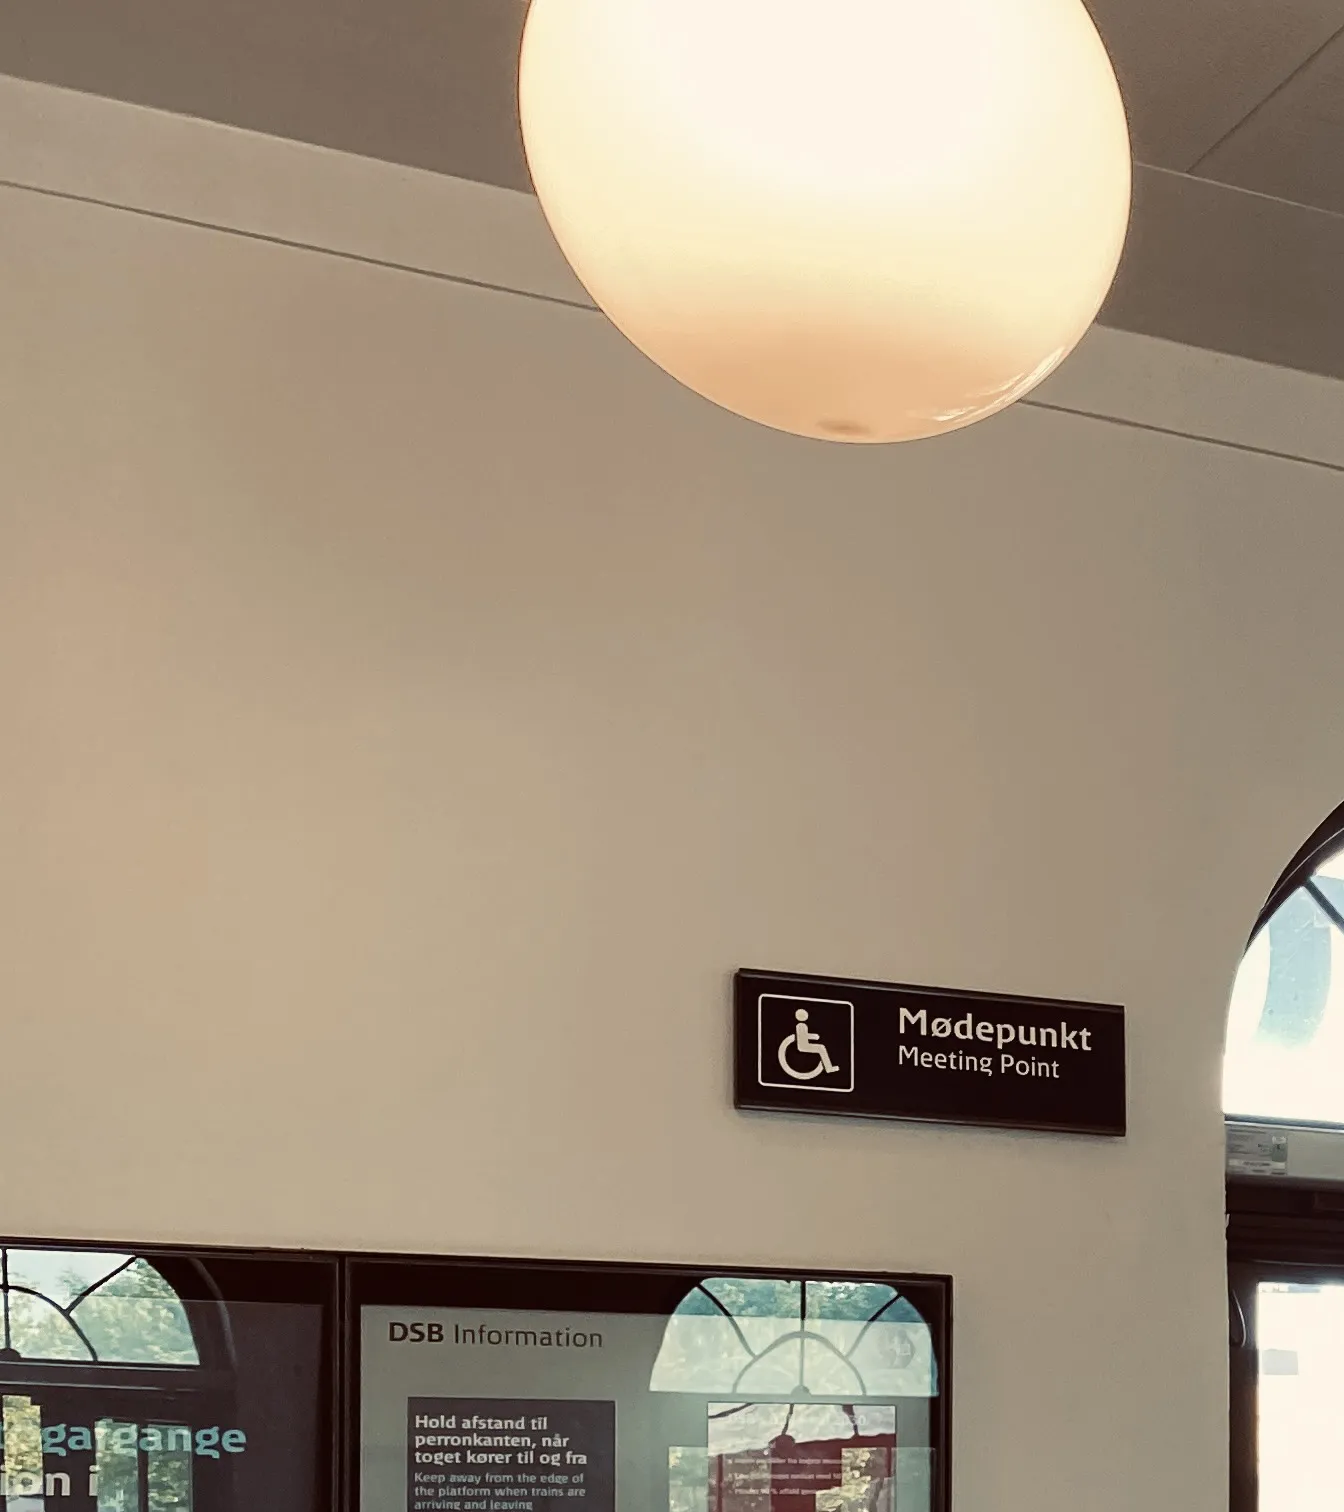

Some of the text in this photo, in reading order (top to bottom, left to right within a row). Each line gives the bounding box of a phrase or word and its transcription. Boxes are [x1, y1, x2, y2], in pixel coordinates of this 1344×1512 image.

[899, 1007, 1092, 1051] Mødepunkt
[899, 1046, 1059, 1079] Meeting Point
[389, 1322, 603, 1347] DSB Information
[415, 1415, 548, 1430] Hold afstand til
[415, 1433, 570, 1449] perronkanten, når
[415, 1450, 587, 1466] toget kører til og fra
[414, 1472, 584, 1484] Keep away from the edge of
[414, 1486, 434, 1496] the
[438, 1486, 491, 1497] platform
[494, 1486, 528, 1496] when
[531, 1487, 564, 1496] trains
[414, 1500, 533, 1511] arriving and leaving
